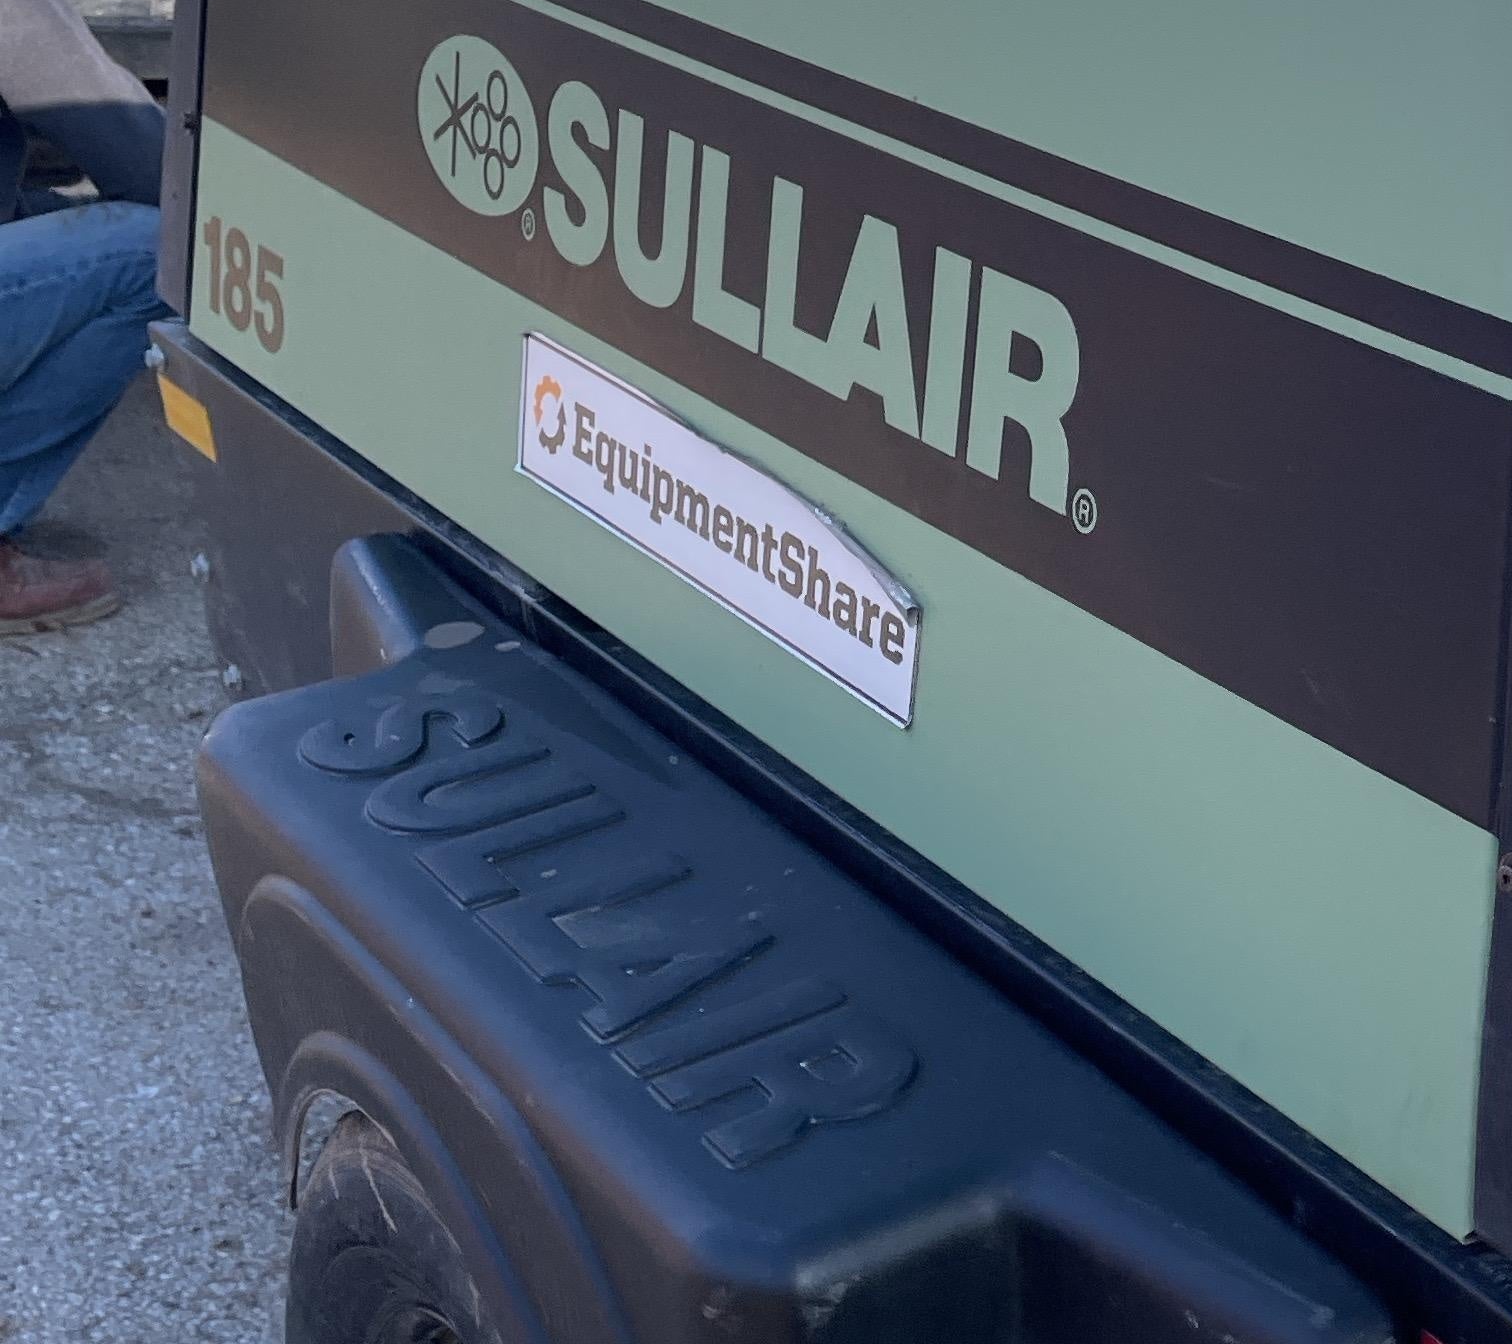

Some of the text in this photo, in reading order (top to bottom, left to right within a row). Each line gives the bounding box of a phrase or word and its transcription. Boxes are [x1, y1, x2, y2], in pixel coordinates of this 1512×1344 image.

[204, 214, 285, 354] 185
[541, 79, 1081, 518] SULLAIR
[572, 400, 906, 664] EquipmentShare
[296, 688, 921, 1171] SULLAIR
